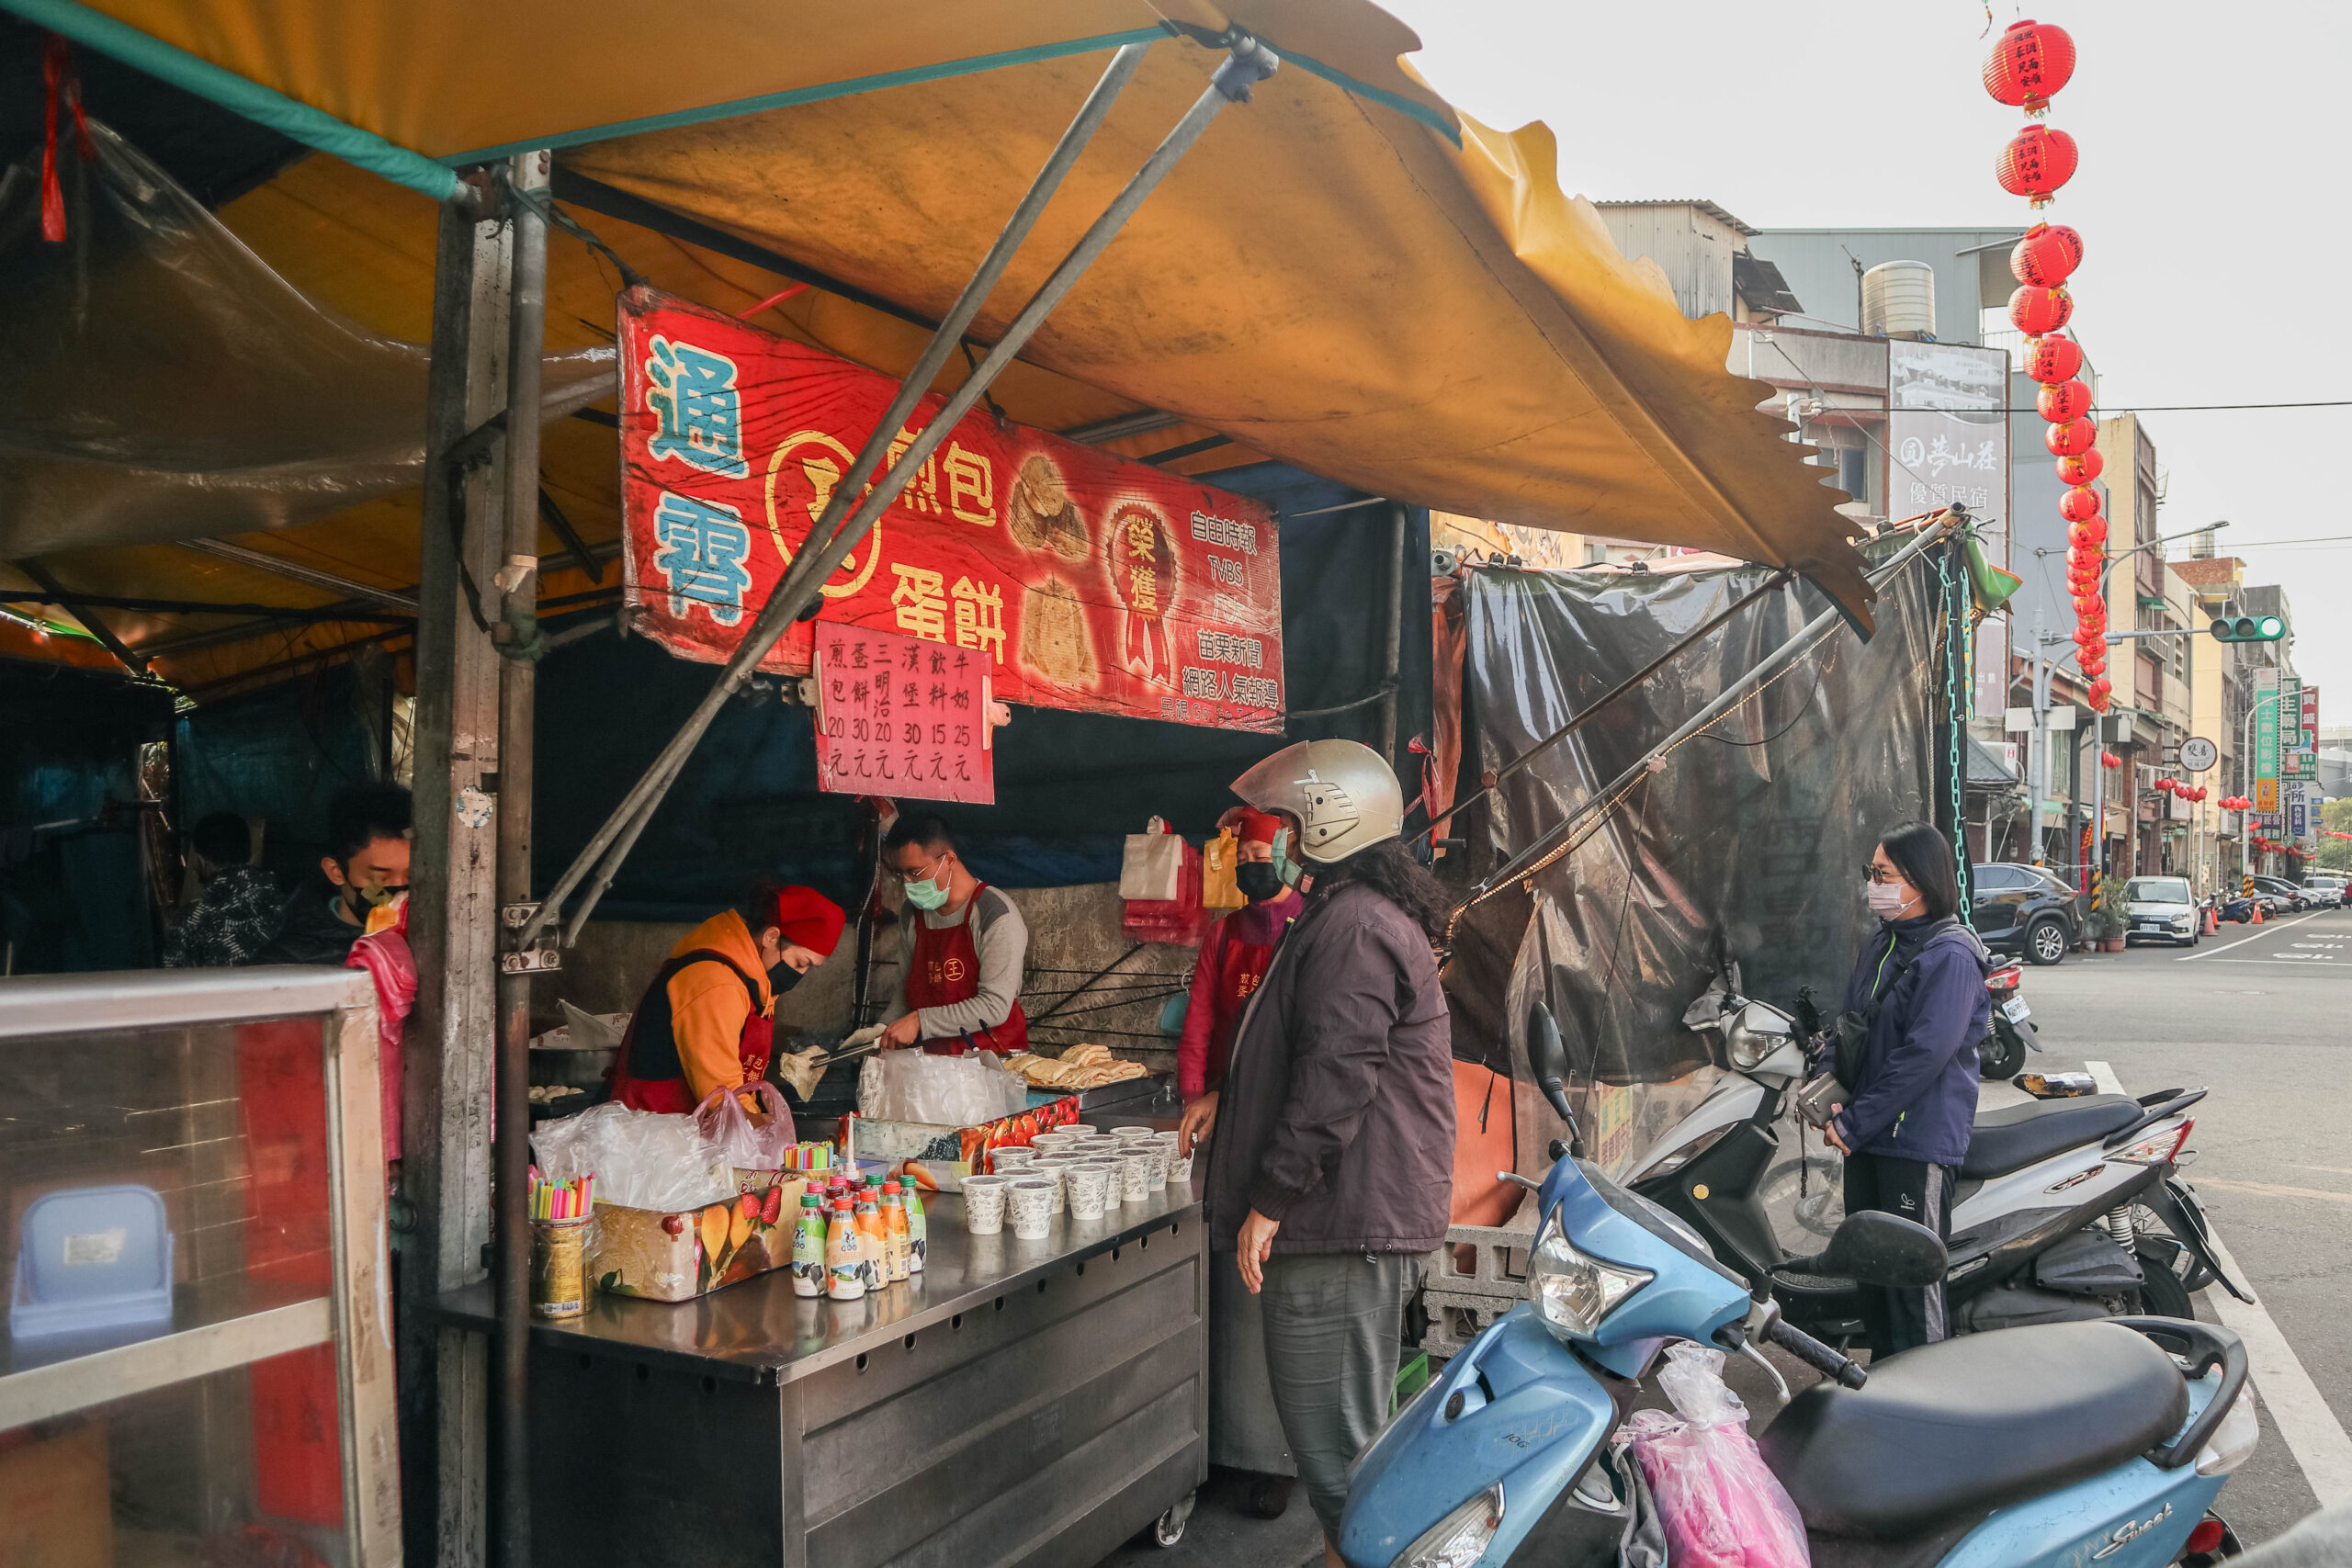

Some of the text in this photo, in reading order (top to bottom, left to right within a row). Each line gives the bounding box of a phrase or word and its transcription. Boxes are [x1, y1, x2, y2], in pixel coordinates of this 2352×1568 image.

[1911, 481, 1987, 509] 優質民宿
[1191, 510, 1257, 556] 自由時報
[1126, 513, 1159, 612] 榮獲
[1208, 556, 1244, 585] TVBS
[890, 561, 1007, 665] 蛋餅
[1197, 628, 1262, 669] 苗栗新聞
[1161, 696, 1190, 721] 民視
[1182, 666, 1279, 710] 網路人氣報導
[1501, 1433, 1530, 1450] JOG
[2091, 1502, 2174, 1560] Sweet
